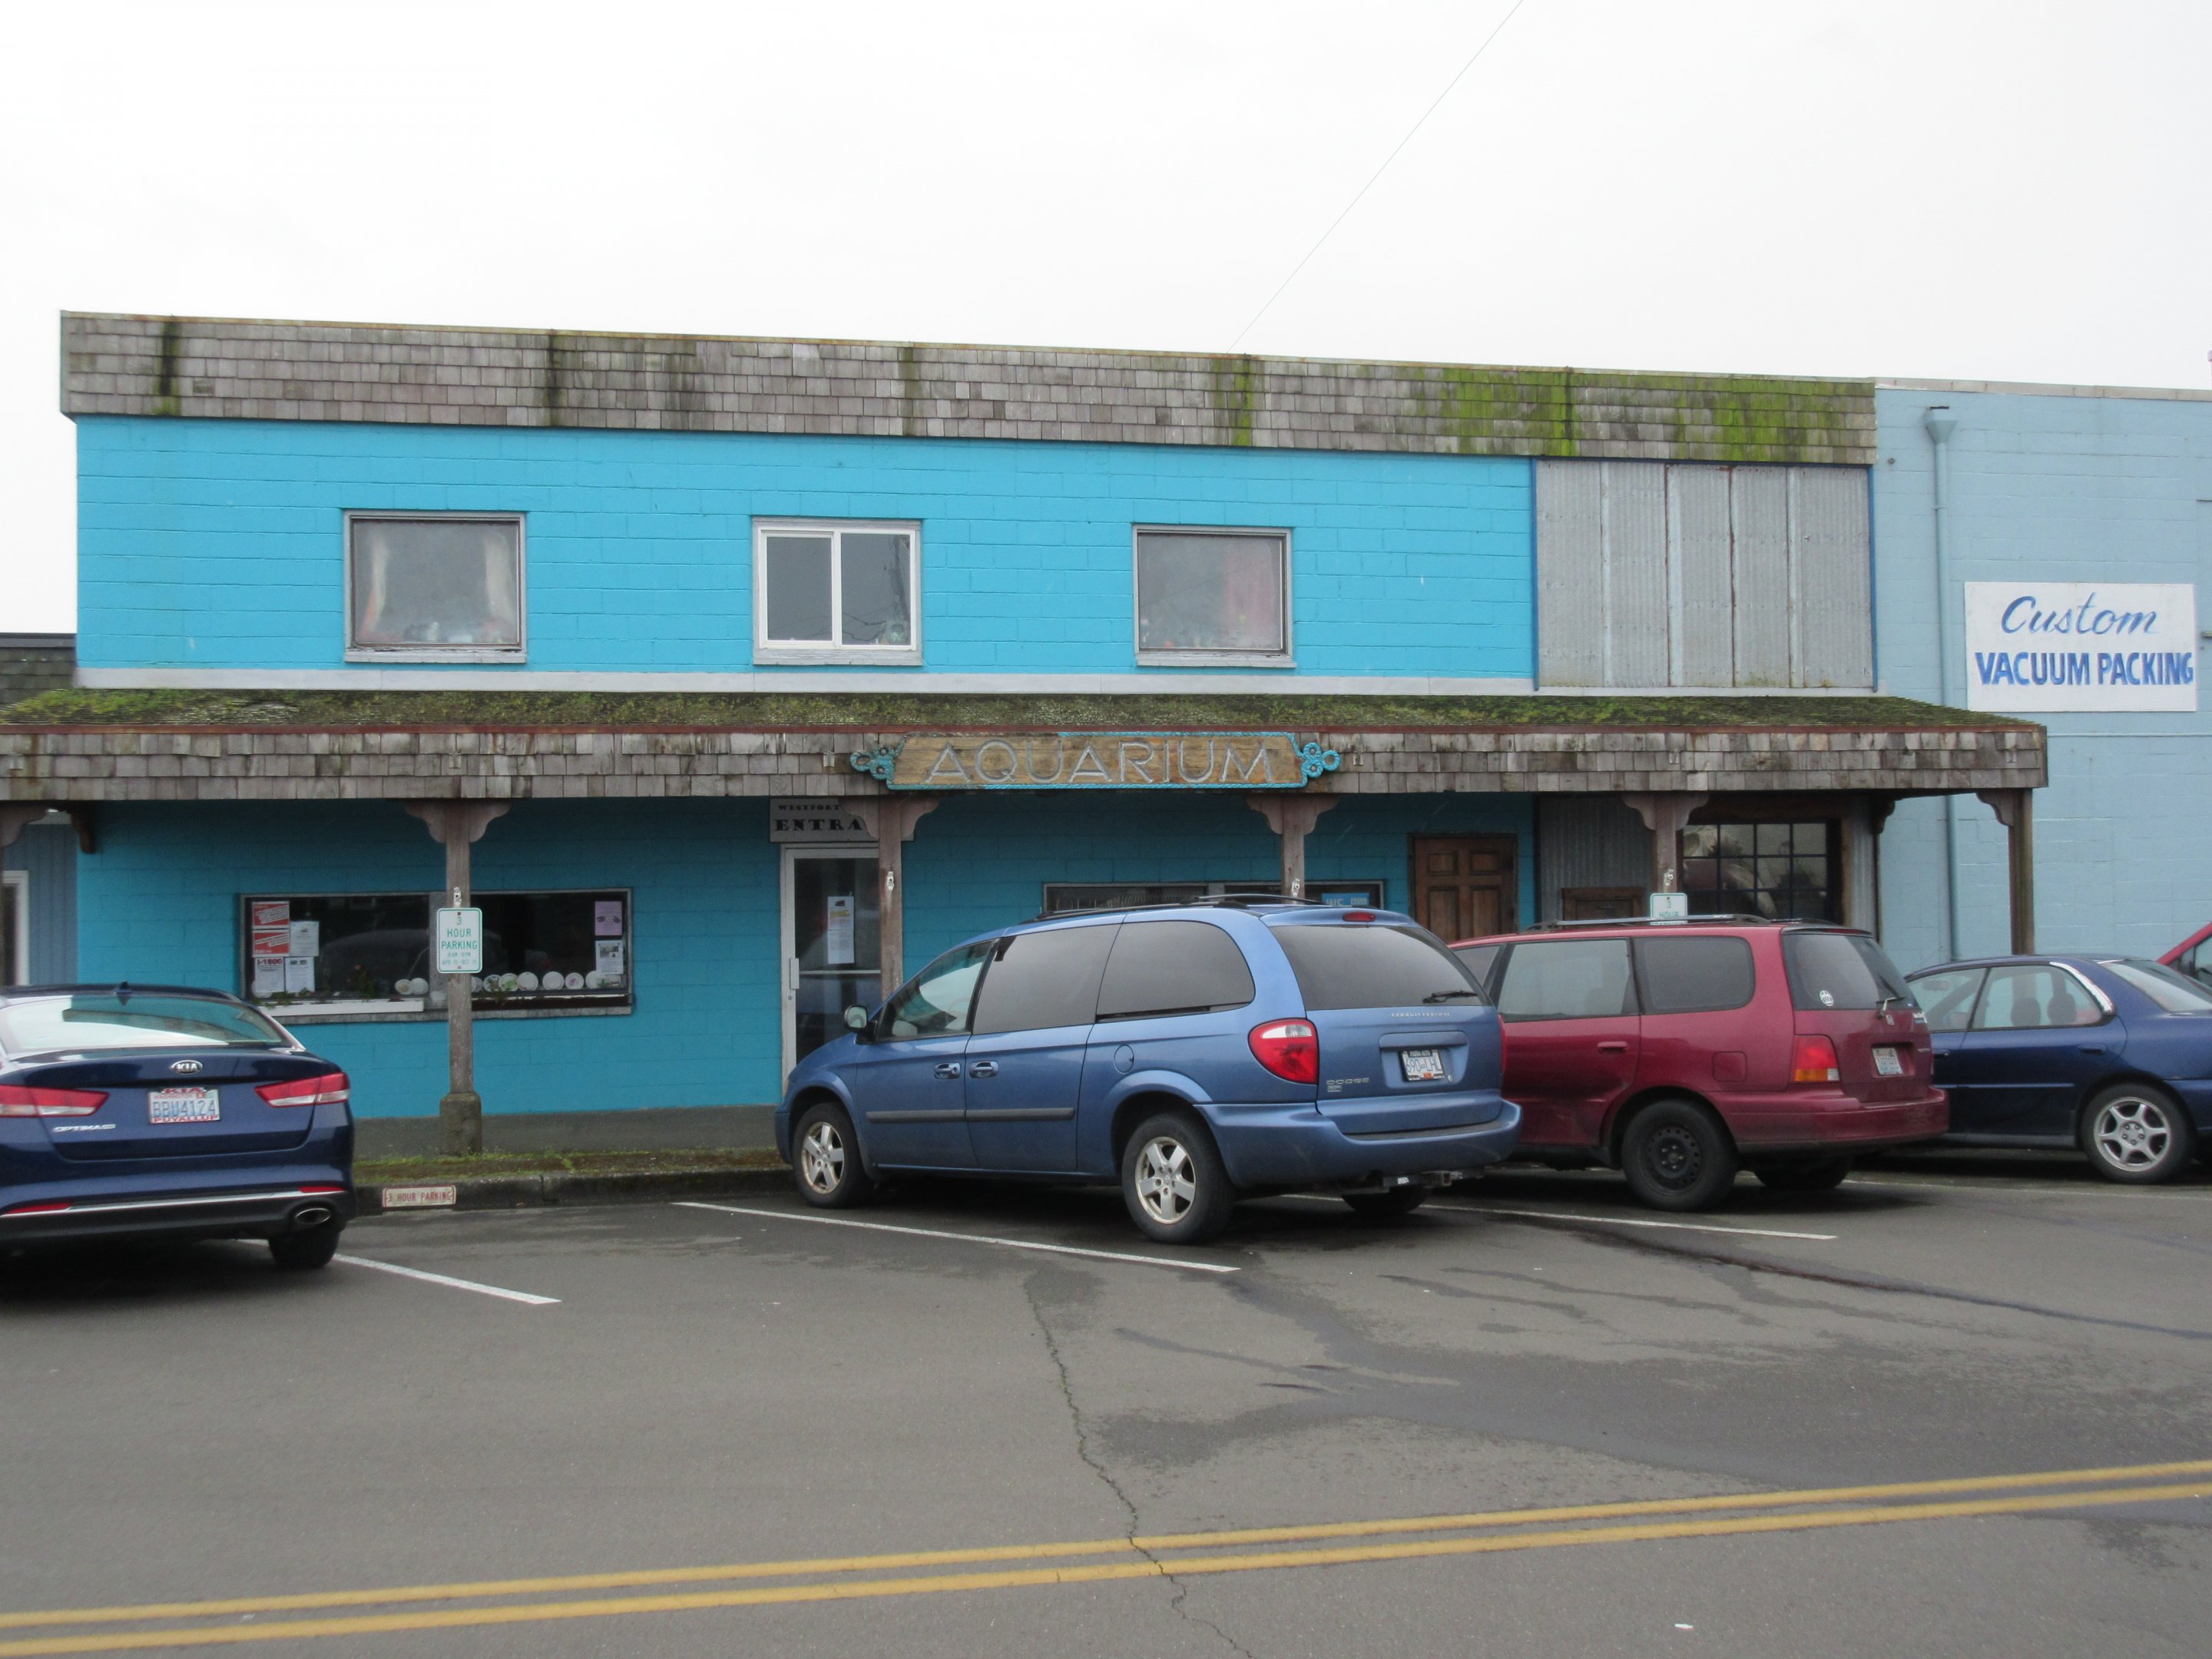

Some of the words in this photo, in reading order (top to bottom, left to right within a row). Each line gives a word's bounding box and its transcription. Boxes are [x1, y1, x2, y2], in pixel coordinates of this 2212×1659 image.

[2001, 592, 2158, 635] Custom
[1975, 651, 2091, 686] VACUUM
[2098, 651, 2194, 685] PACKING
[925, 739, 1275, 784] AQUARIUM
[774, 818, 863, 831] ENTRA
[456, 916, 462, 926] 3
[447, 928, 472, 938] HOUR
[441, 941, 478, 950] PARKING
[177, 1063, 199, 1071] KIA
[397, 1191, 417, 1202] HOUR
[420, 1190, 453, 1201] PARKING
